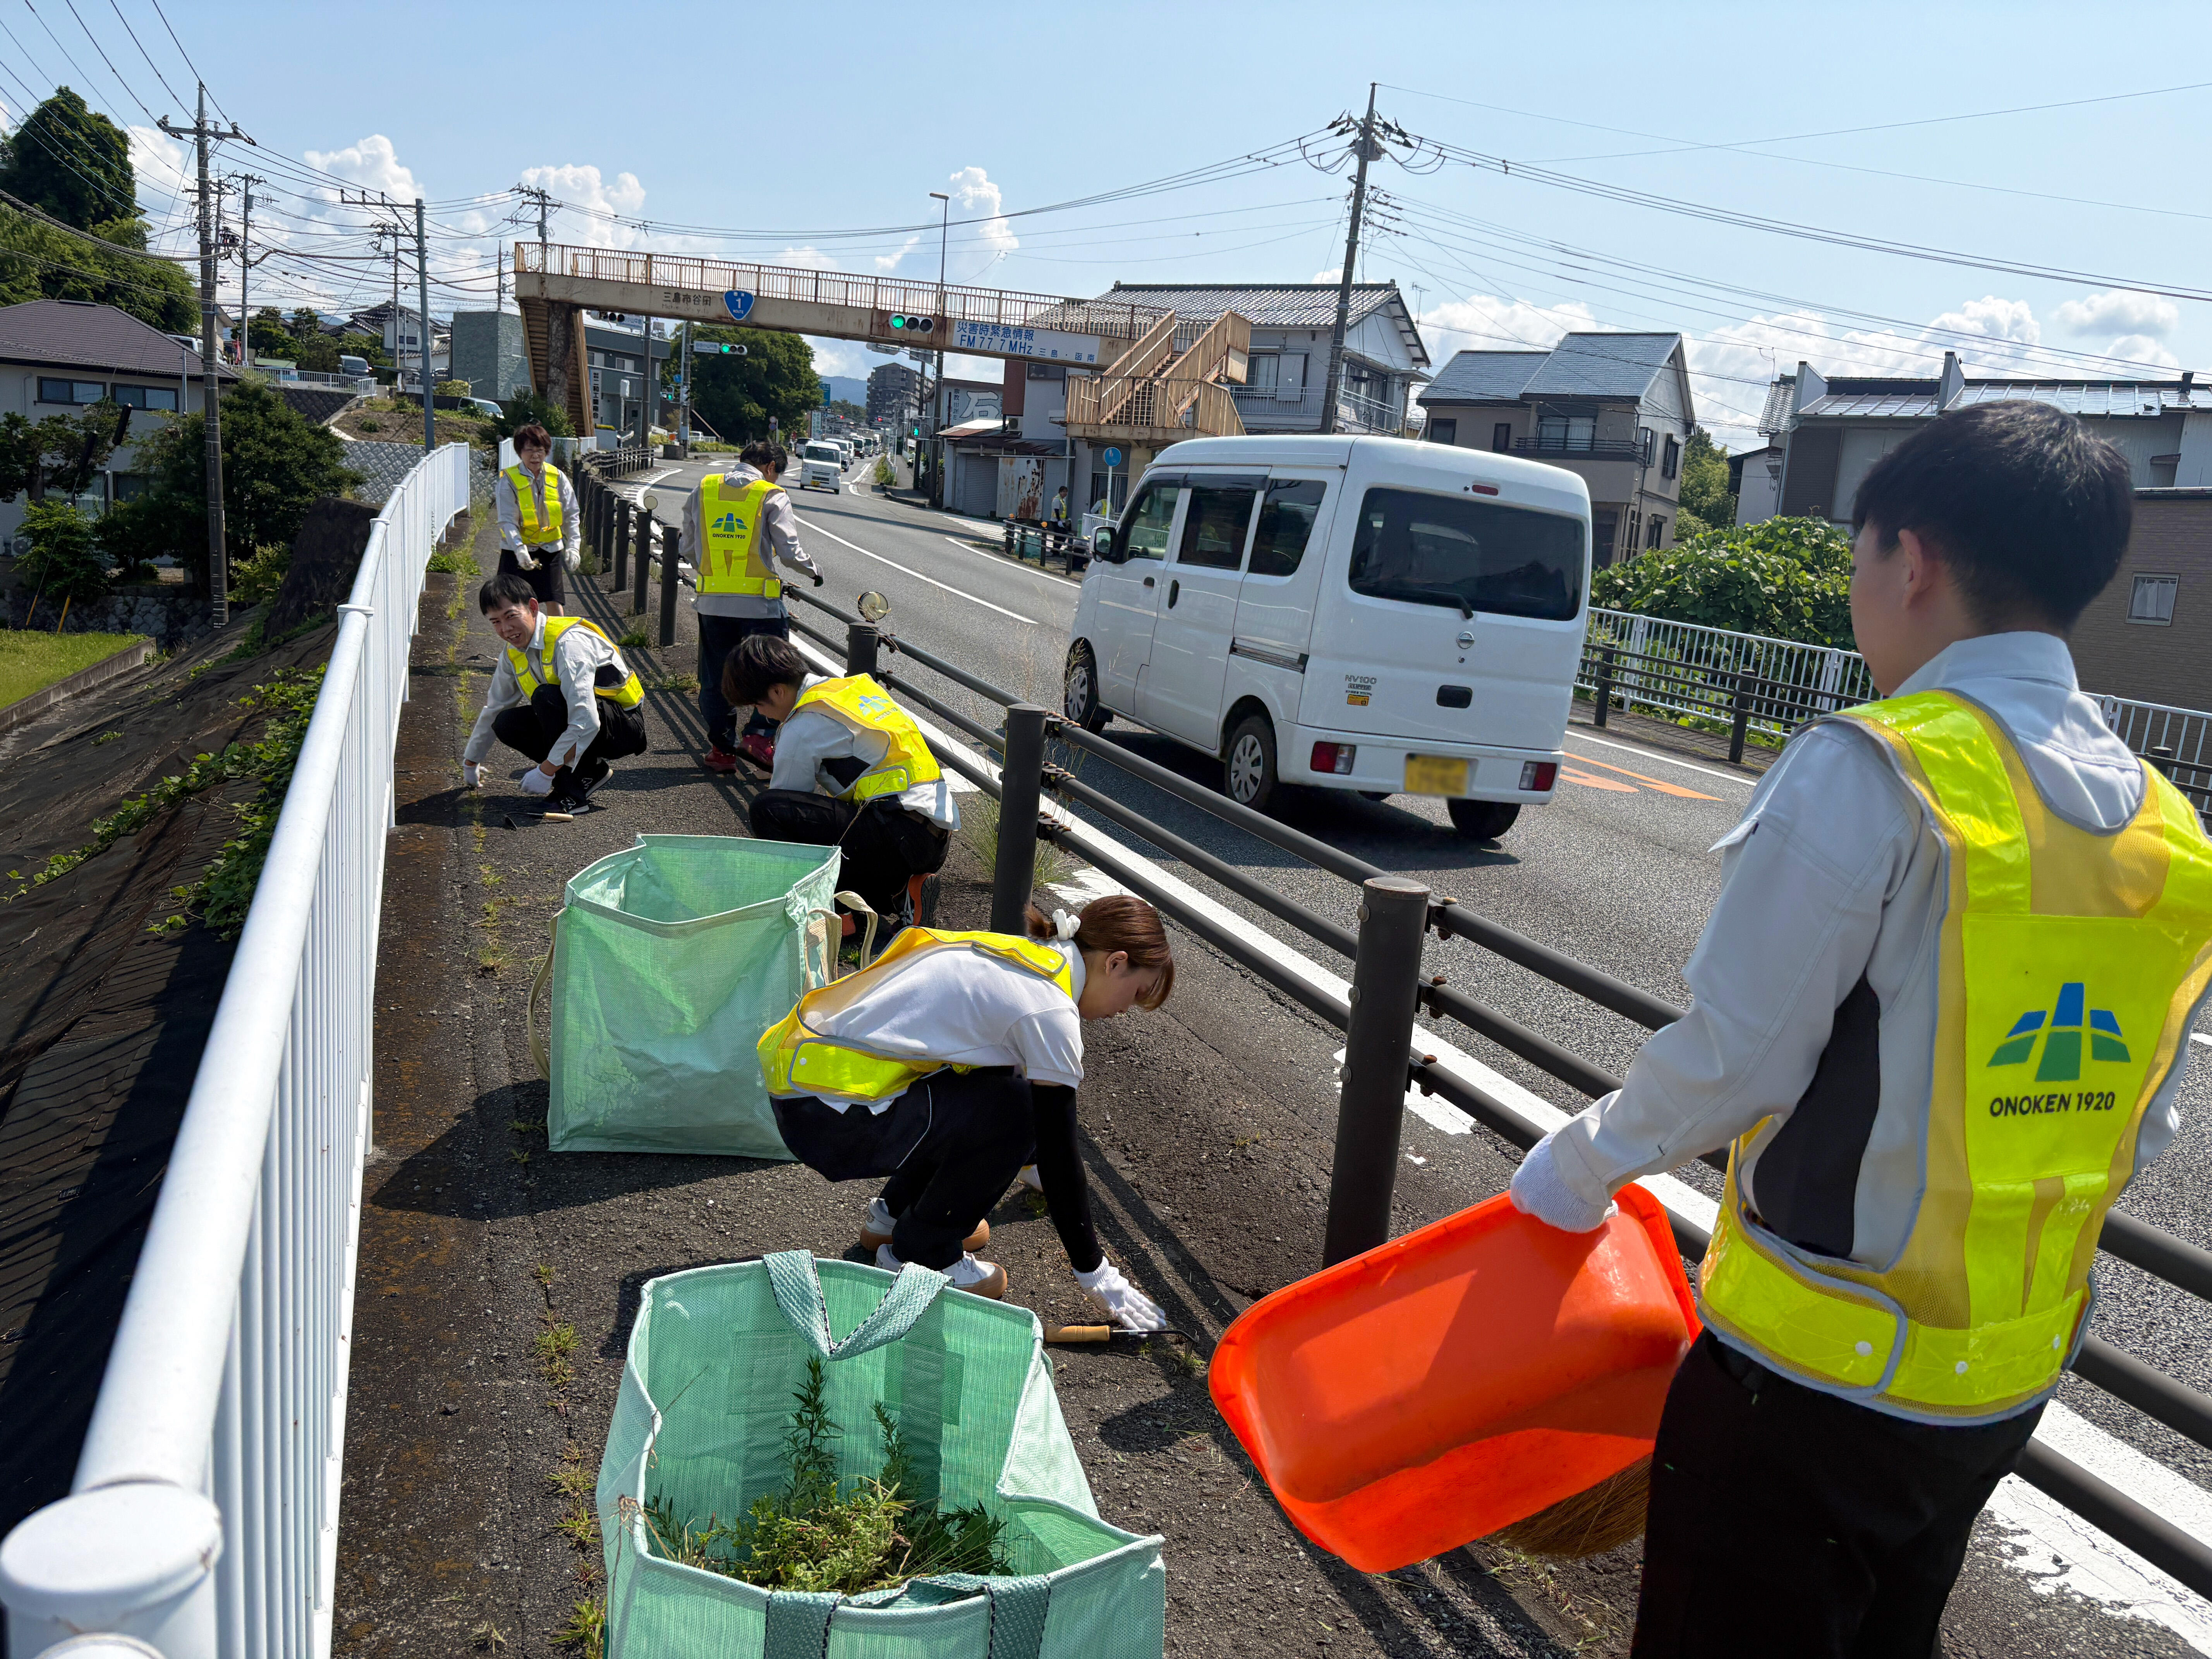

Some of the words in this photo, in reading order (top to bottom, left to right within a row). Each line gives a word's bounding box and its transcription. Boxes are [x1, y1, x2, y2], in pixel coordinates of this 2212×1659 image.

[736, 298, 741, 309] 1
[957, 321, 1034, 341] 災害時緊急情報
[960, 334, 975, 348] FM
[980, 337, 1005, 351] 77.7
[1008, 340, 1033, 354] MHz
[1345, 675, 1377, 684] NV100
[1990, 1093, 2072, 1117] ONOKEN
[2076, 1091, 2116, 1113] 1920
